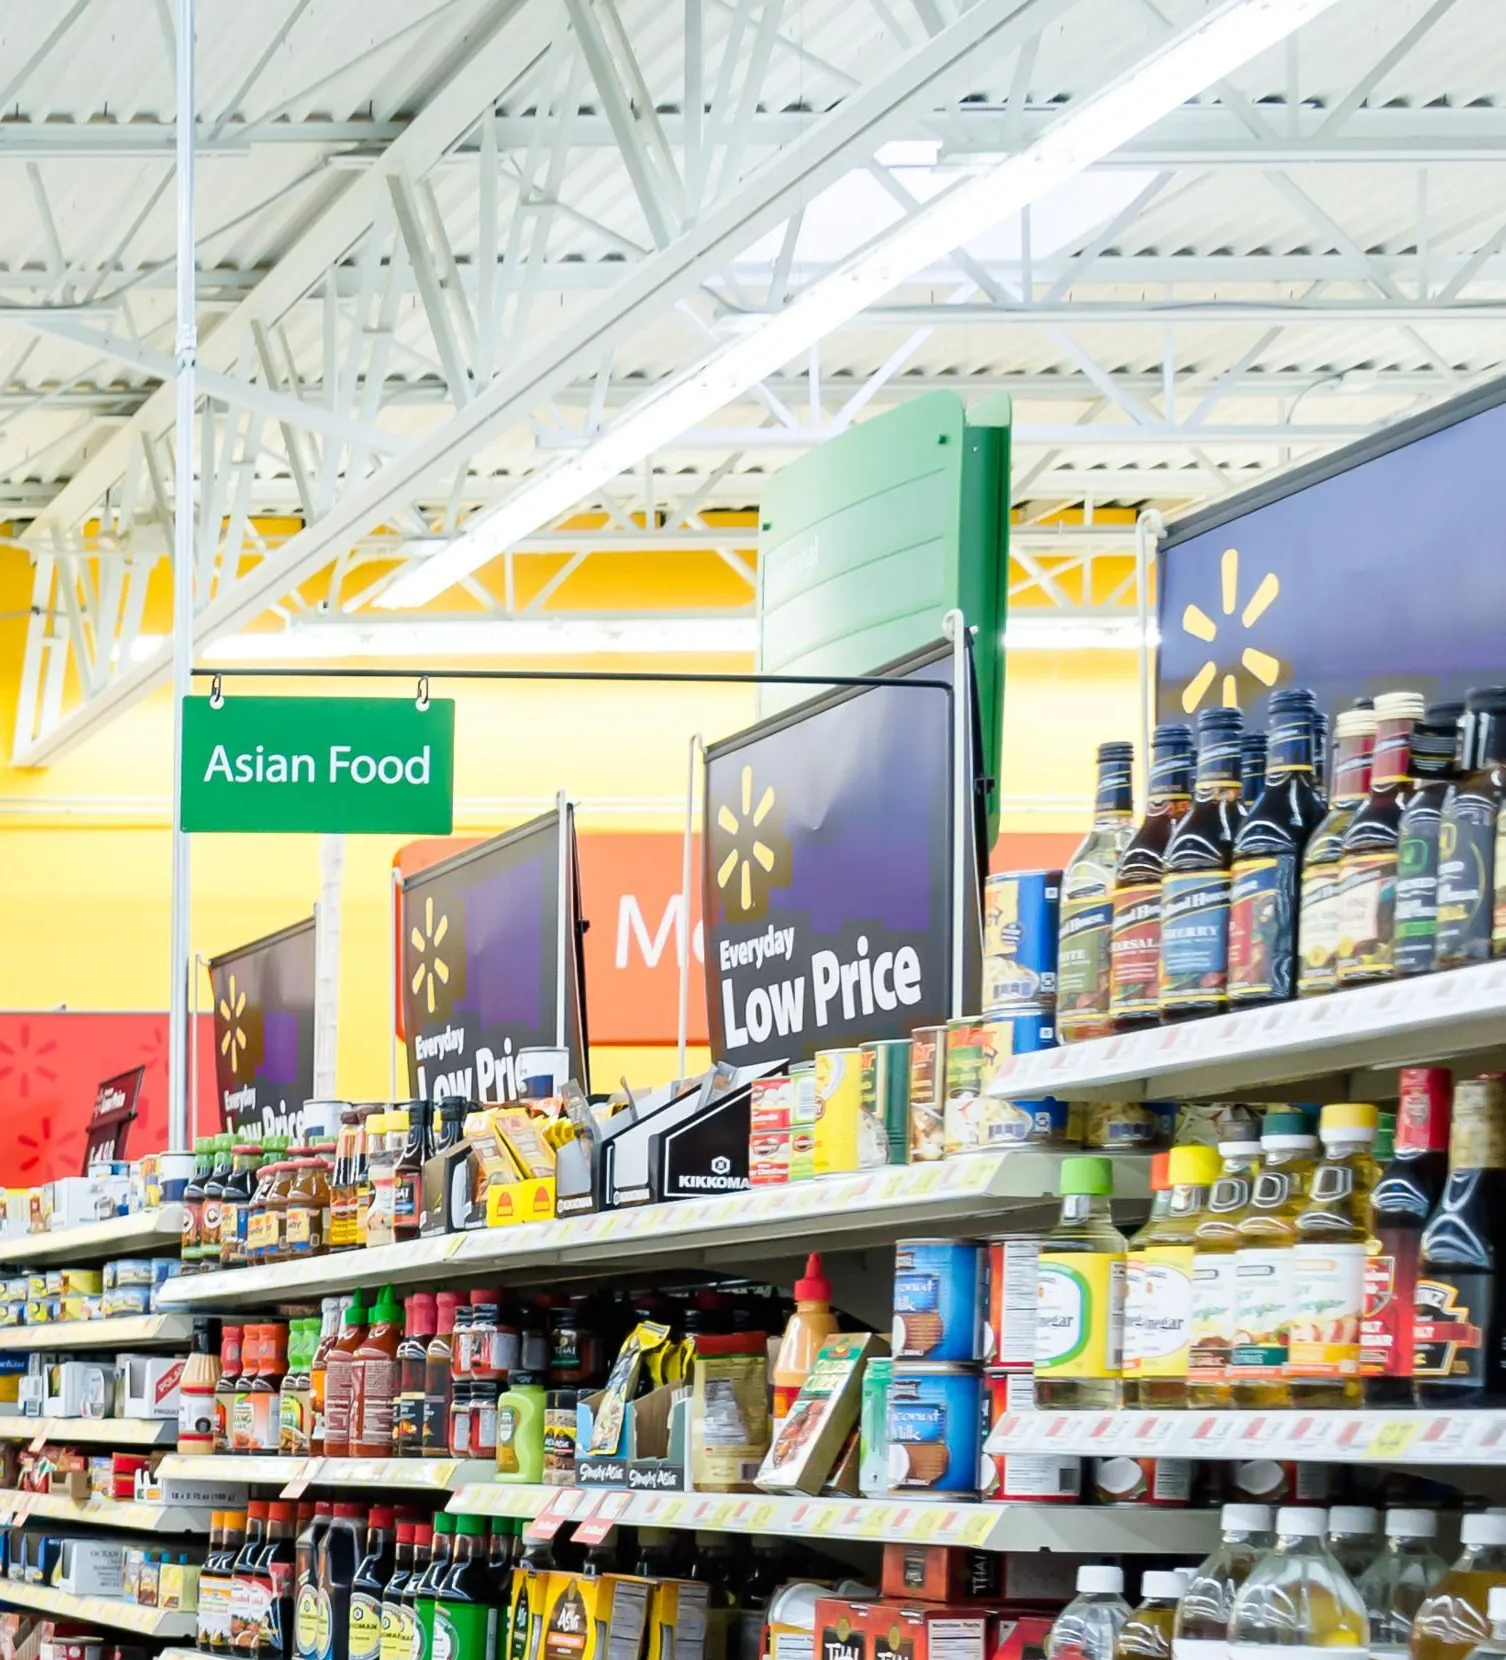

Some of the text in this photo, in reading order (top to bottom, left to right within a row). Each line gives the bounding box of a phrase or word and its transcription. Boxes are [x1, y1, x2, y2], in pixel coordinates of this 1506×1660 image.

[203, 744, 431, 785] Asian Food
[719, 924, 795, 972] Everyday
[721, 935, 922, 1050] Low Price
[415, 1025, 465, 1062] Everyday
